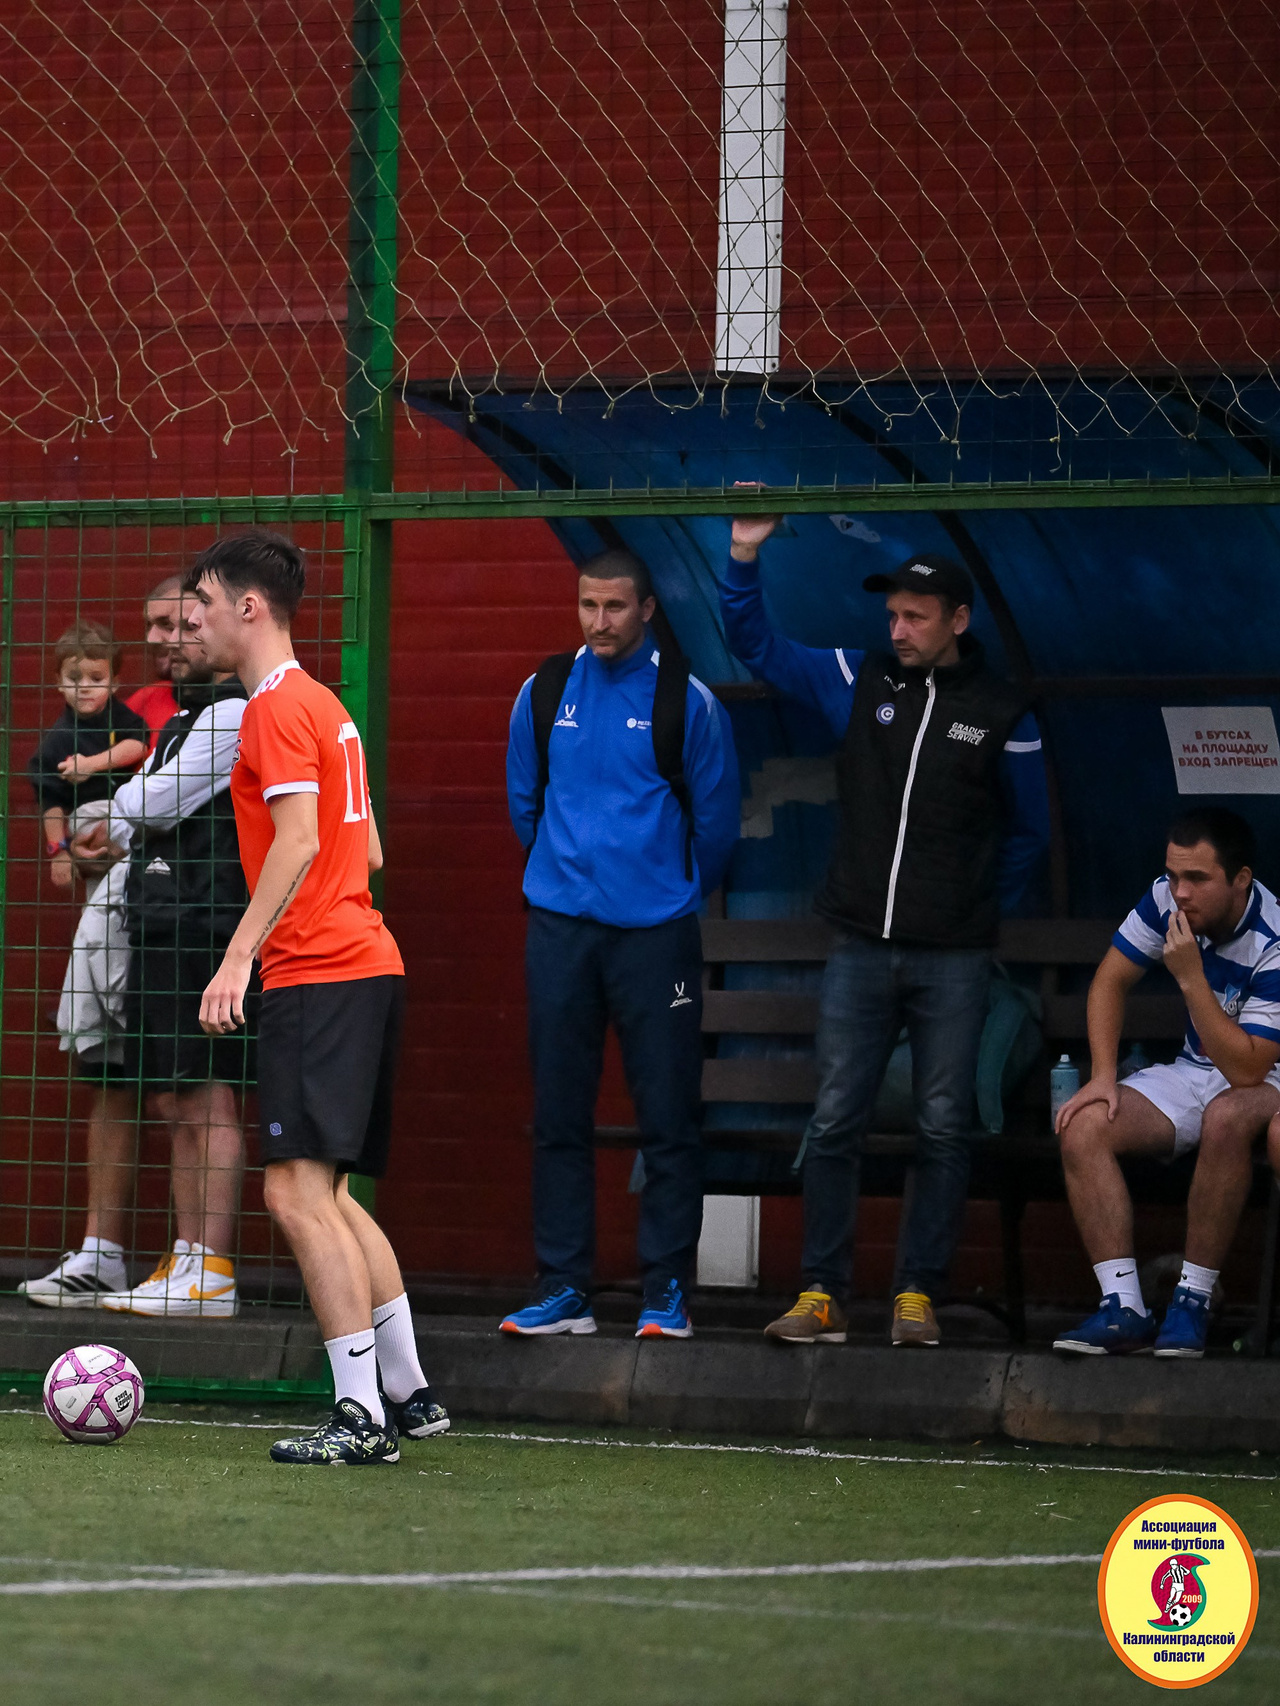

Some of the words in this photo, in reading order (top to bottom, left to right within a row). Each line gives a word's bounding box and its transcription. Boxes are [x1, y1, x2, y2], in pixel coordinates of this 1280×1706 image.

[952, 722, 986, 738] GRADUS
[1194, 730, 1203, 740] В
[1206, 730, 1252, 740] БУТСАХ
[1182, 744, 1198, 754] НА
[1202, 744, 1269, 755] ПЛОЩАДКУ
[1178, 756, 1211, 768] ВХОД
[1214, 756, 1278, 768] ЗАПРЕЩЕН
